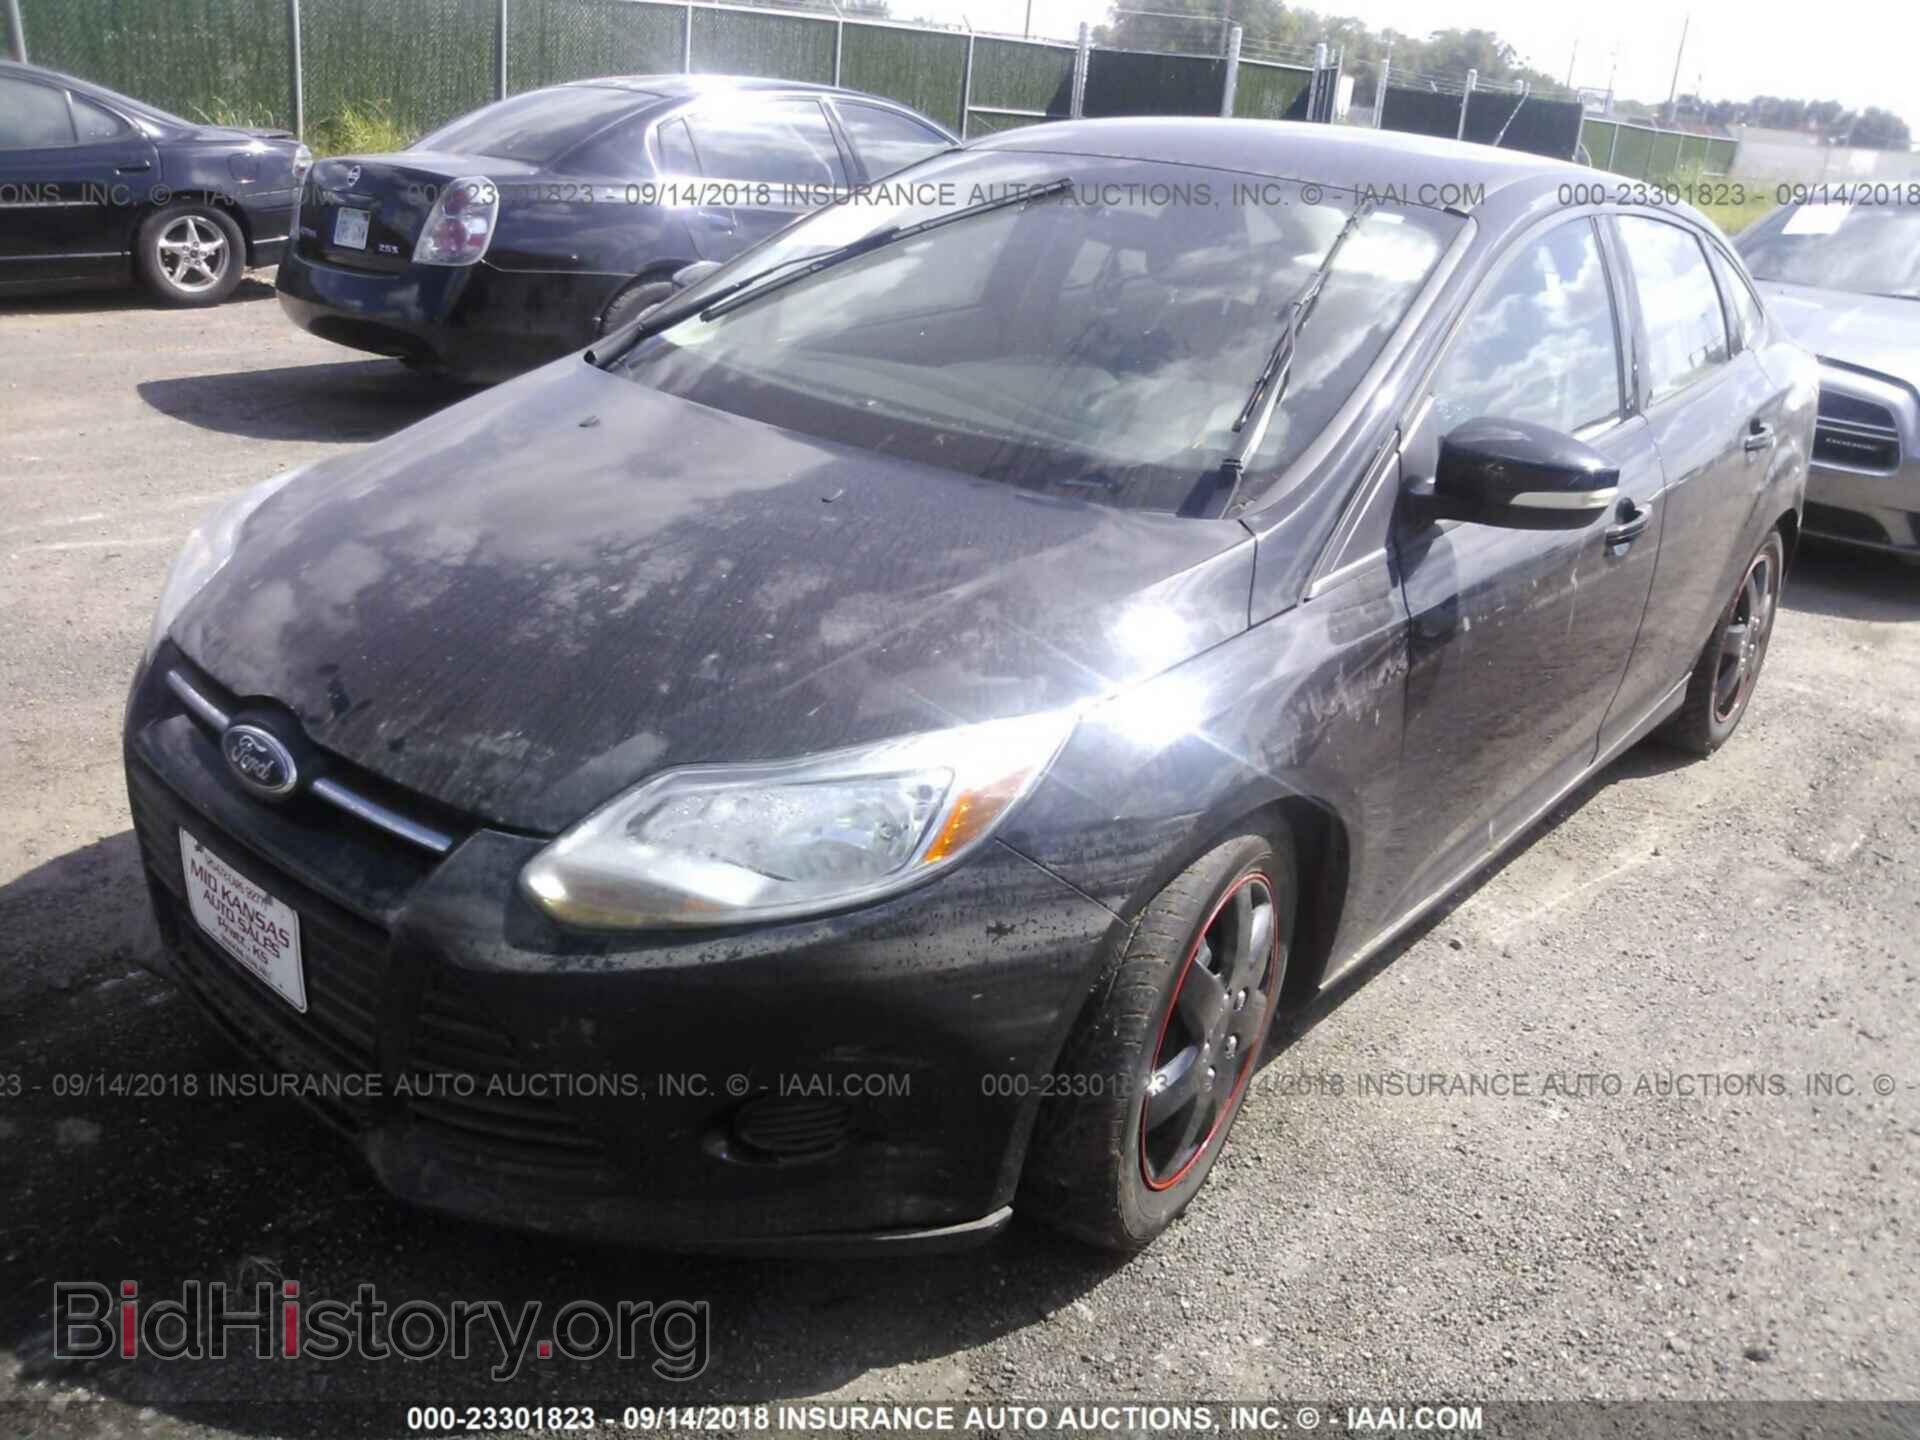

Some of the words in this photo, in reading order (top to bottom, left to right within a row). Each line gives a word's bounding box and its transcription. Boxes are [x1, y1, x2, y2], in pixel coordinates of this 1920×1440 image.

[230, 734, 276, 782] Ford
[190, 857, 218, 894] MID
[221, 888, 291, 949] KANSAS
[202, 888, 236, 924] AUTO
[238, 914, 281, 960] SALES
